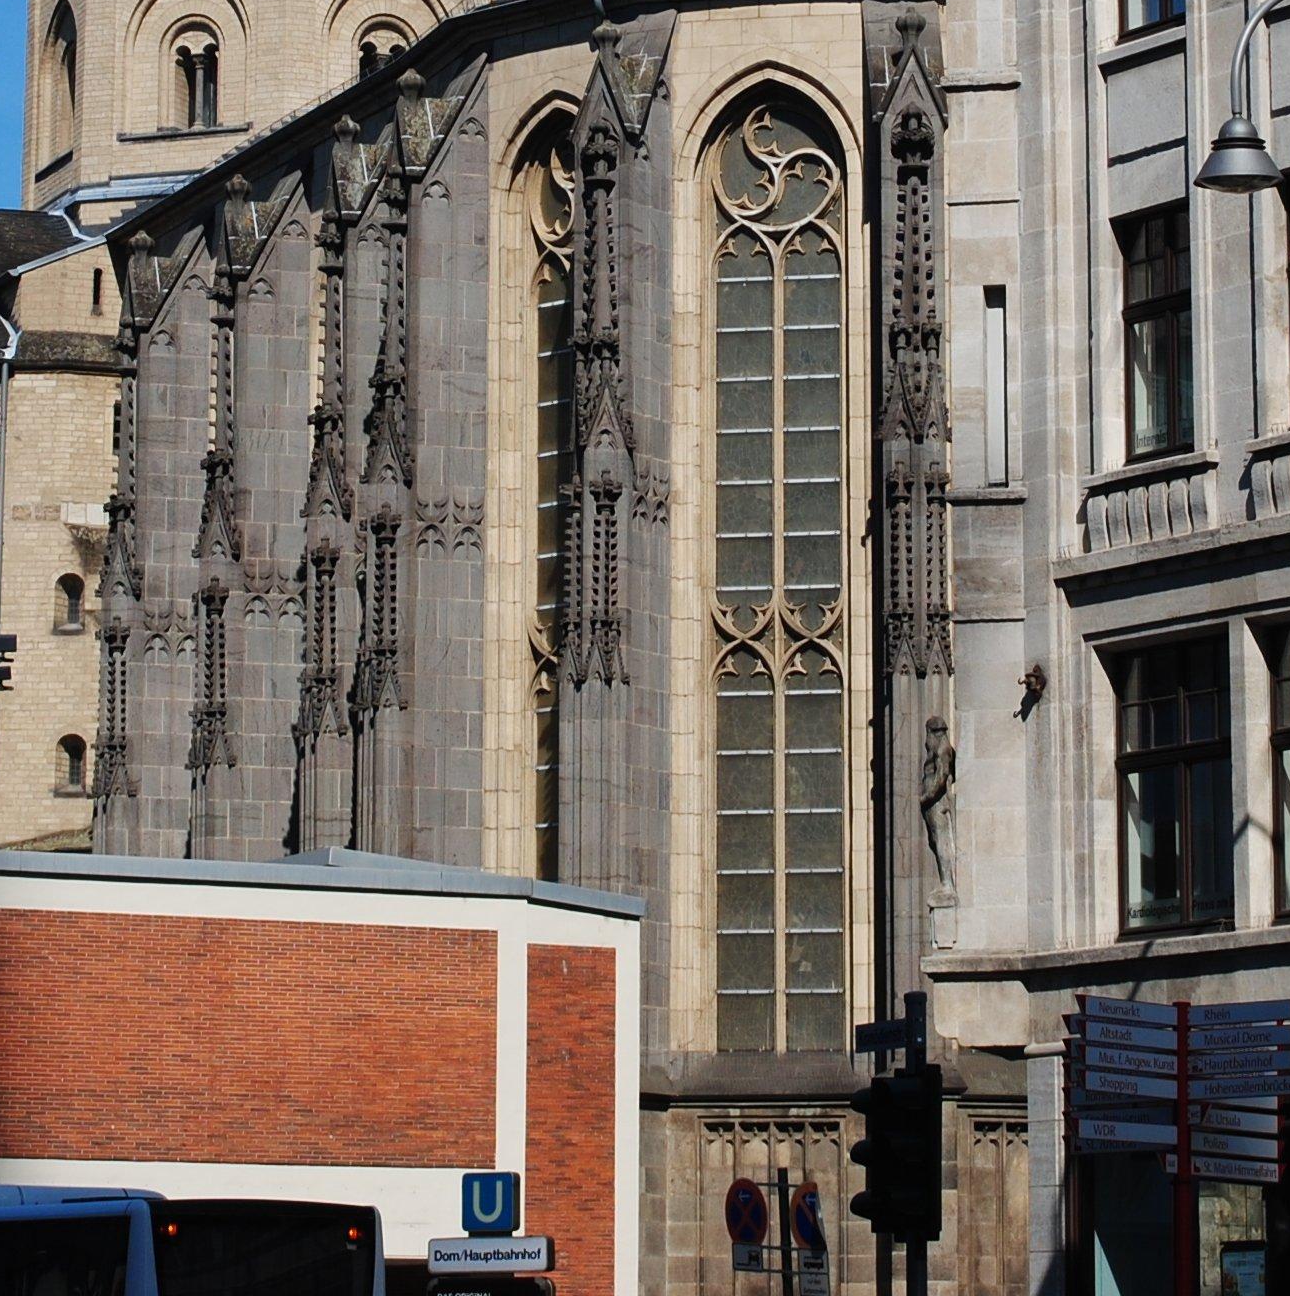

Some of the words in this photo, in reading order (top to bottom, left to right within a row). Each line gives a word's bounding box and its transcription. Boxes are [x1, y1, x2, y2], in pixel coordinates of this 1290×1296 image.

[1098, 1001, 1141, 1018] Neumarkt
[1204, 1008, 1231, 1021] Rhein
[1099, 1026, 1133, 1042] Altstadt
[1204, 1031, 1240, 1045] Musical
[1242, 1031, 1272, 1043] Dome
[1153, 1057, 1175, 1071] Kunst
[1204, 1054, 1273, 1072] Hauptbahnhof
[1098, 1075, 1138, 1094] Shopping
[1215, 1112, 1241, 1127] Ursula
[1093, 1123, 1116, 1137] WDR
[1203, 1135, 1229, 1150] Polizei
[472, 1180, 503, 1223] U
[434, 1248, 541, 1264] Dom/Hauptbahnhof
